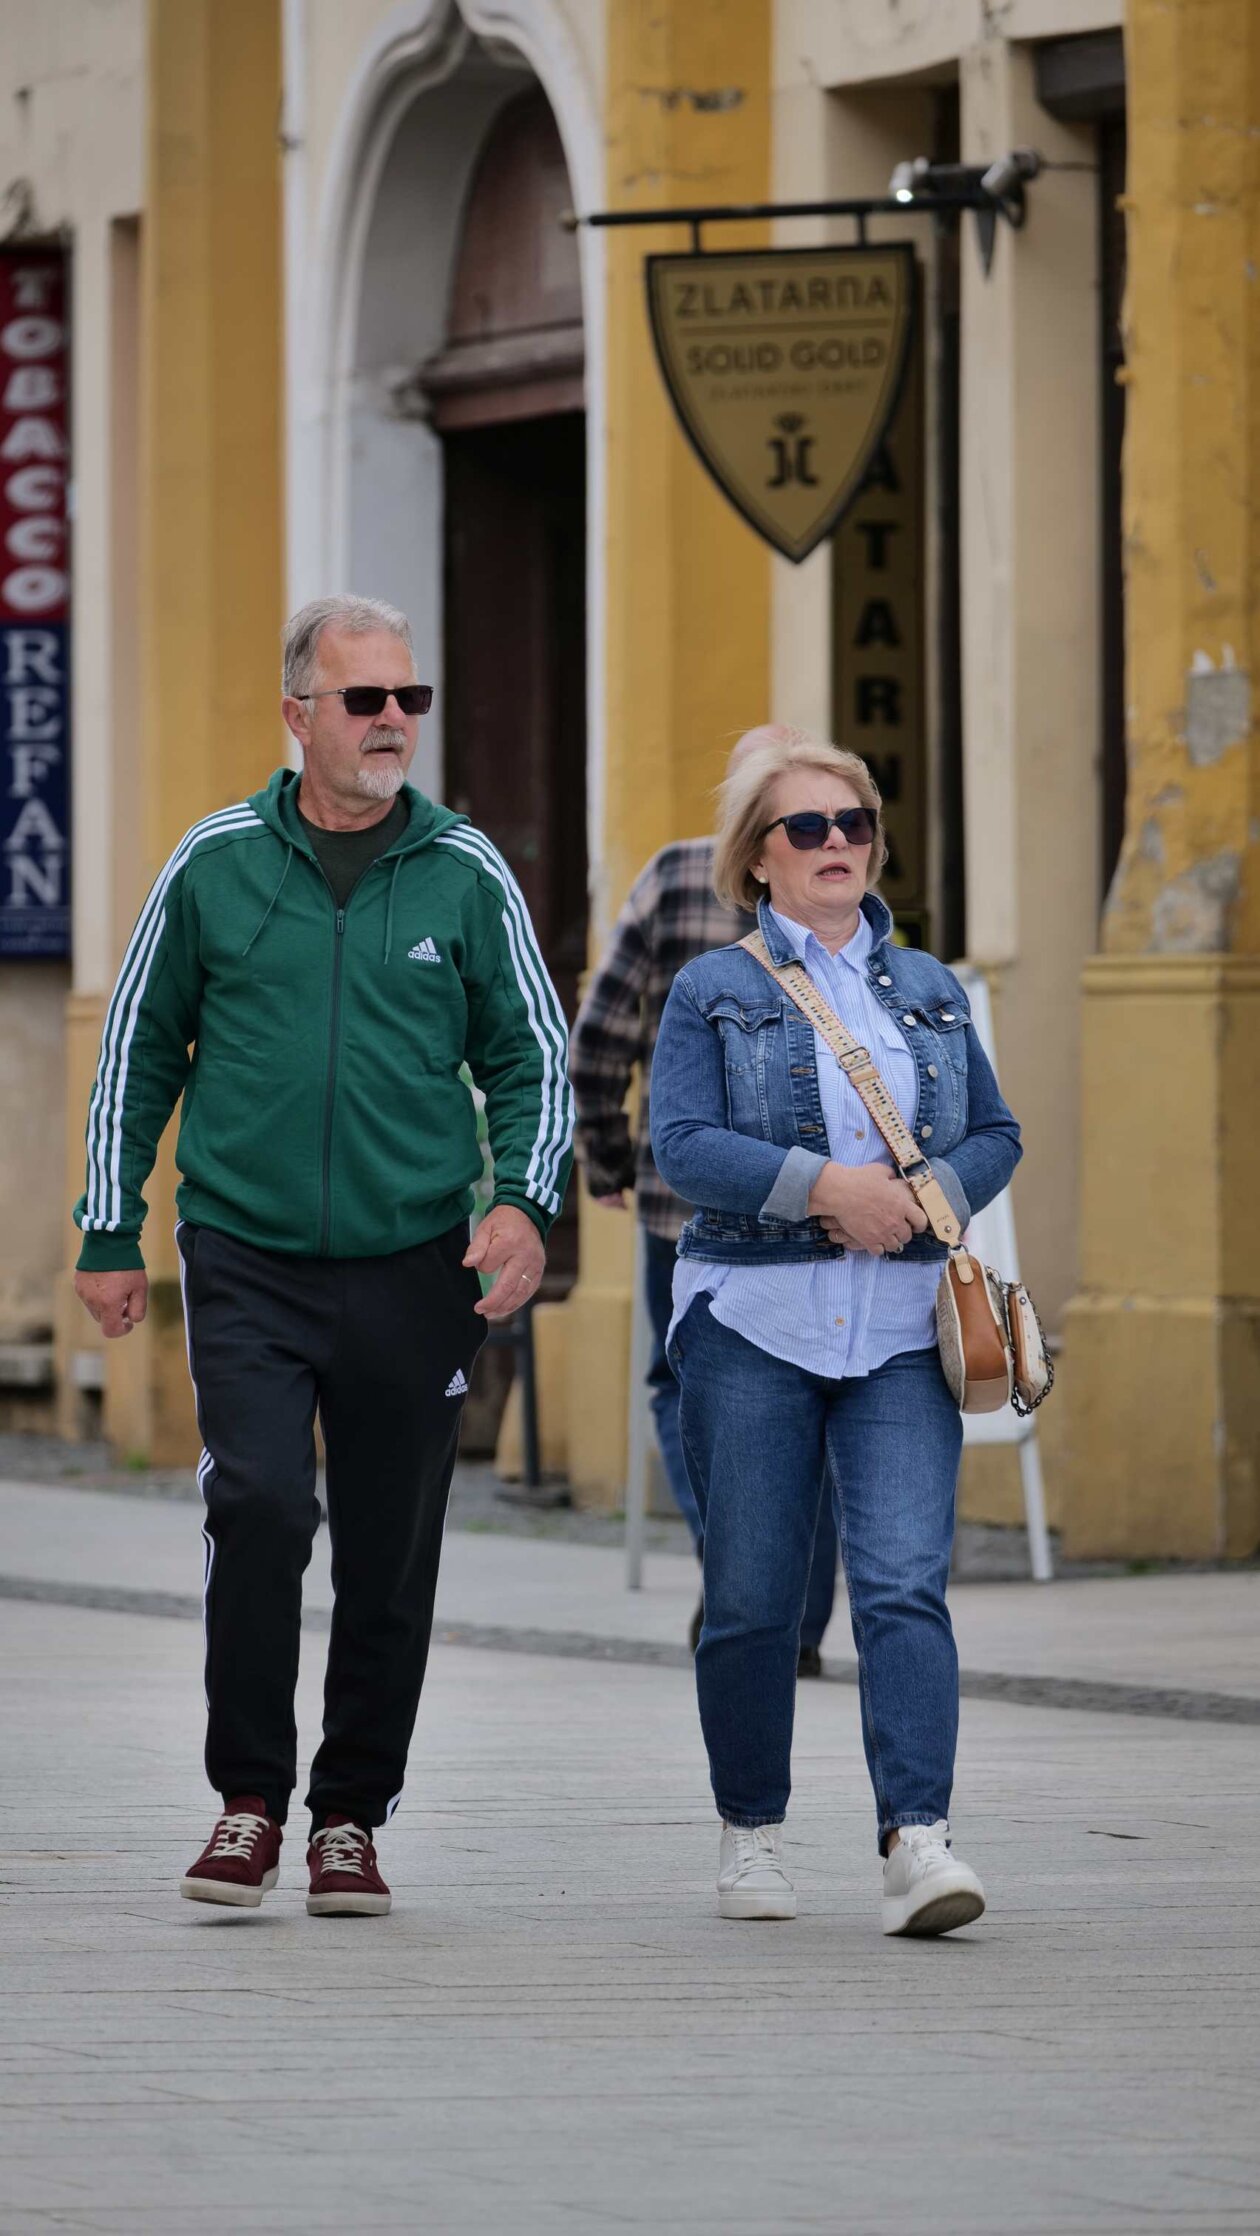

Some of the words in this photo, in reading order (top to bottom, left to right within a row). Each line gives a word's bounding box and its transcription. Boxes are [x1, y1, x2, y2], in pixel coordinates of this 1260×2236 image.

[675, 276, 892, 318] ZLATARNA
[686, 341, 783, 376] SOLID
[790, 337, 886, 371] GOLD
[1, 268, 65, 610] TOBACCO
[4, 629, 65, 909] REFAN
[408, 950, 441, 963] adidas
